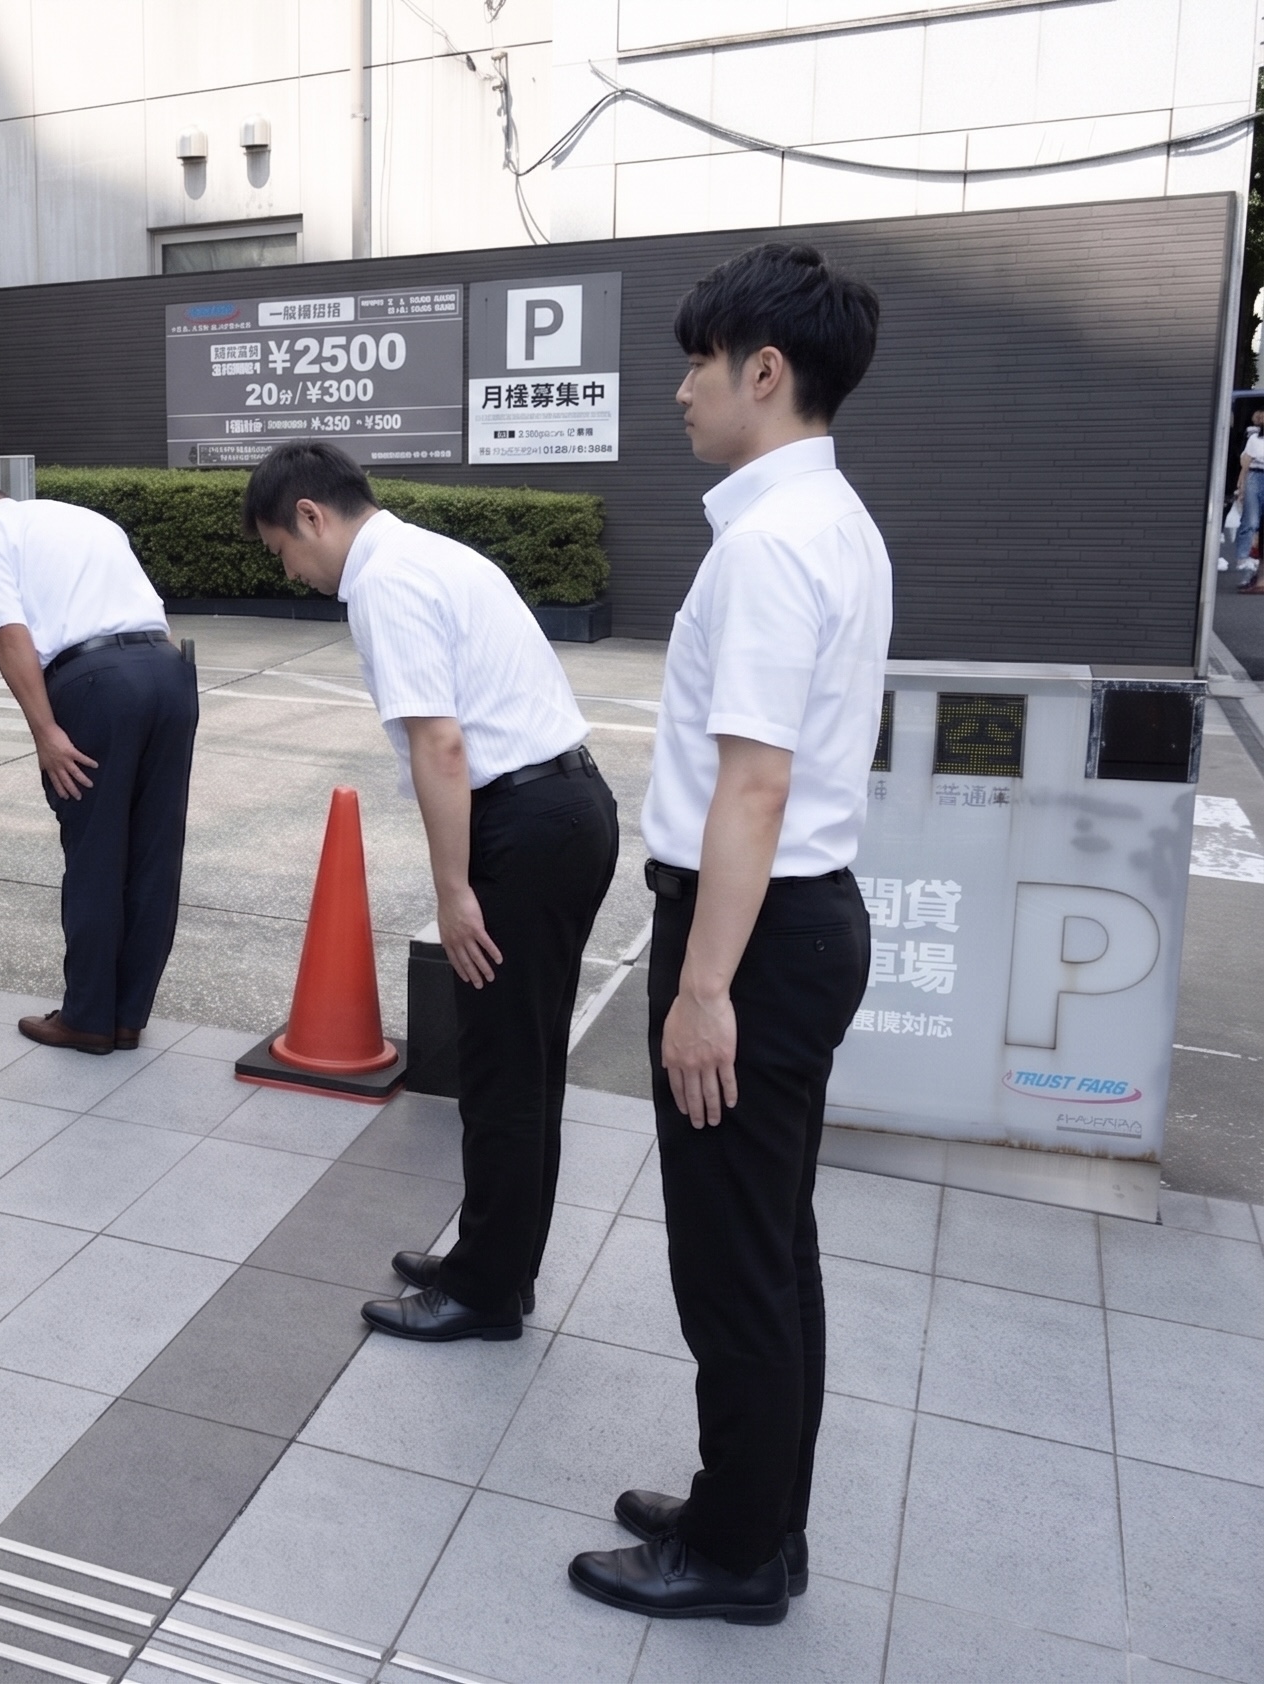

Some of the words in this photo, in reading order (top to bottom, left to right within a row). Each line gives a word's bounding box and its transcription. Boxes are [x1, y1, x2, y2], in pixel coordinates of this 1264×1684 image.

[268, 333, 406, 375] ¥2500
[525, 299, 564, 361] P
[1005, 881, 1161, 1050] P
[1014, 1071, 1075, 1089] TRUST
